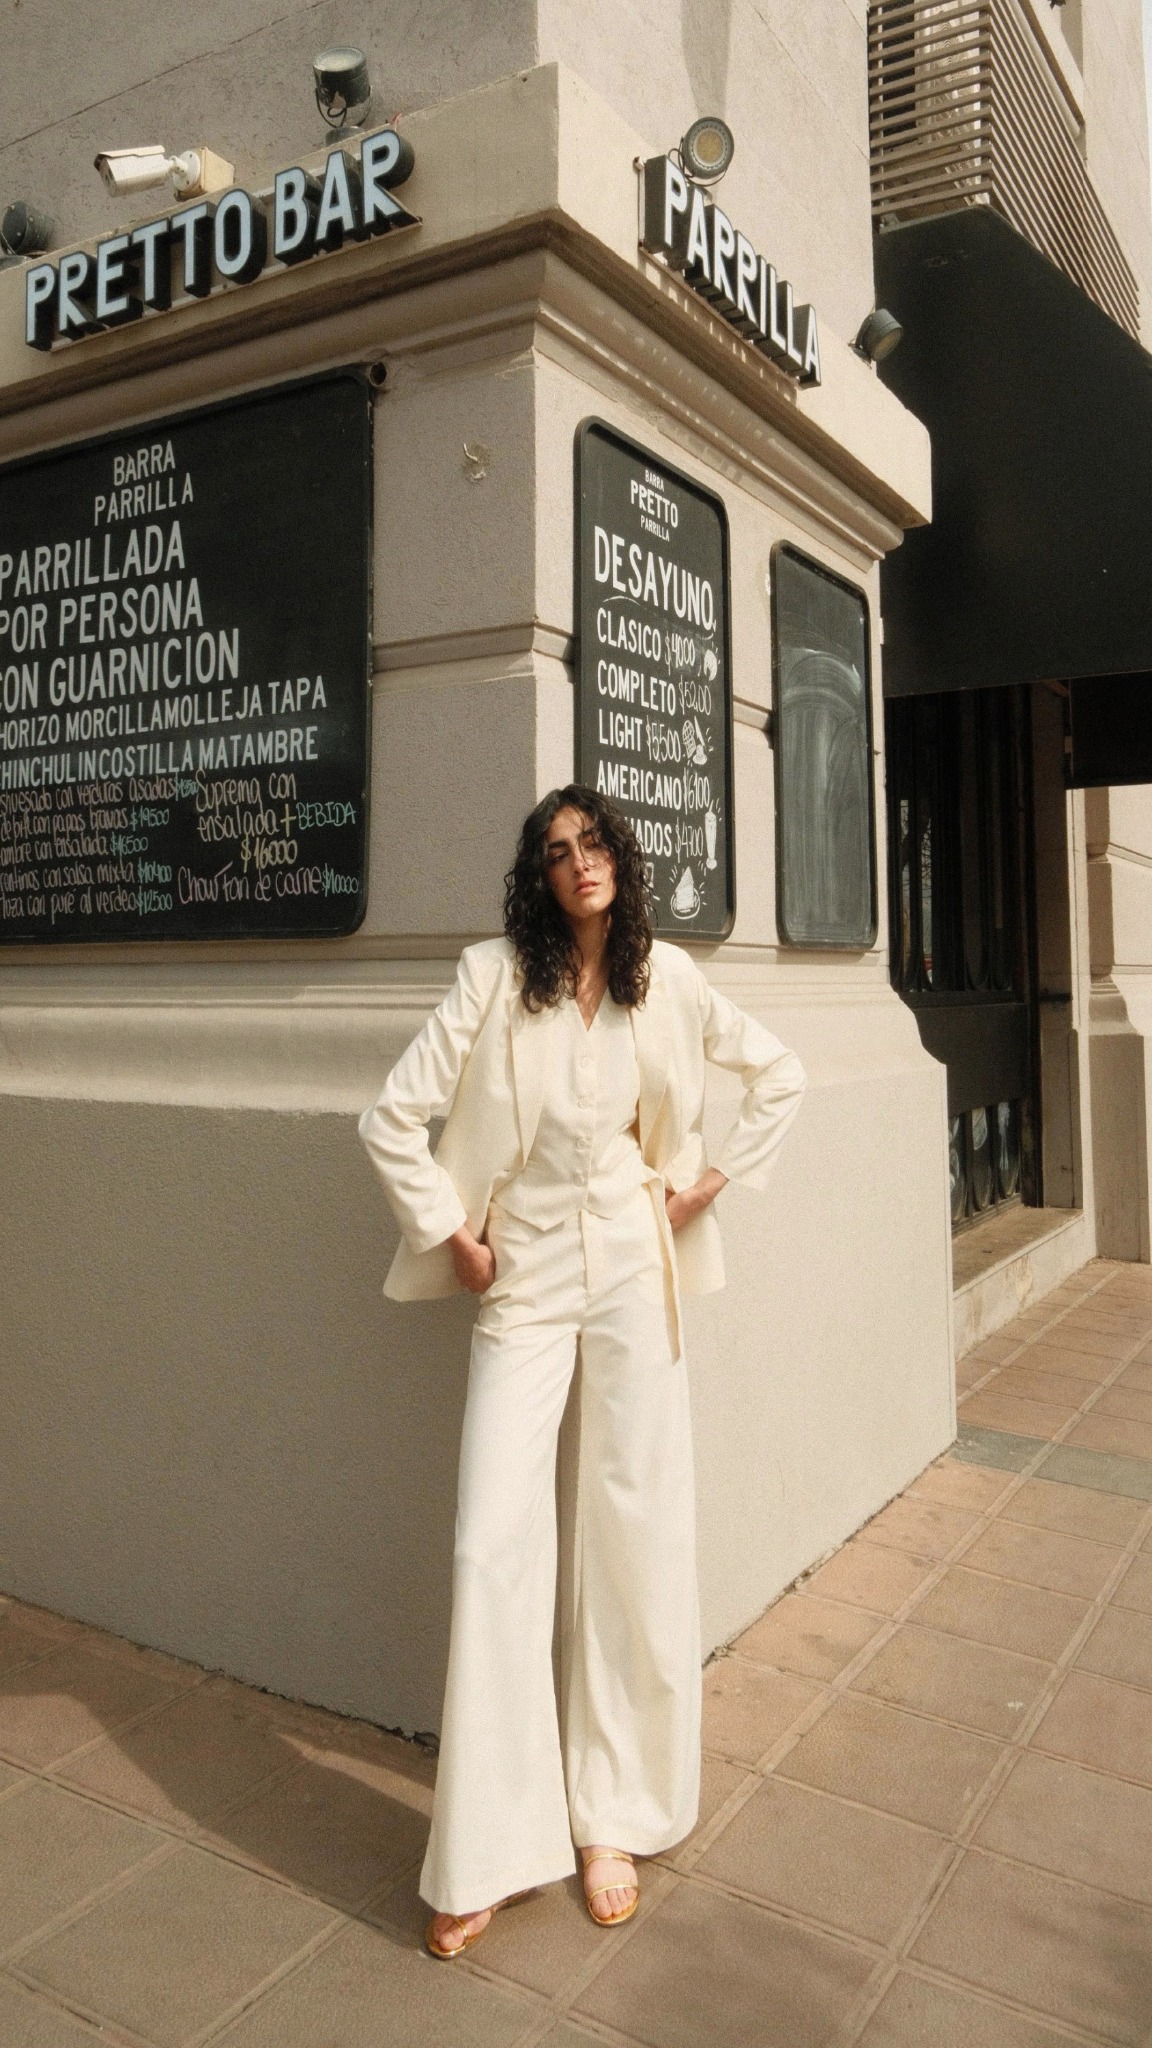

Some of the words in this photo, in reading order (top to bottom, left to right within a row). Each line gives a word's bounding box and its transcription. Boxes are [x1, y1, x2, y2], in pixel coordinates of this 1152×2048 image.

[26, 187, 262, 350] PRETTO
[274, 128, 412, 264] BAR
[660, 155, 821, 387] PARRILLA
[113, 440, 175, 486] BARRA
[645, 469, 665, 492] BARRA
[95, 472, 194, 526] PARRILLA
[630, 479, 679, 528] PRETTO
[640, 514, 670, 543] PARRILLA
[0, 520, 186, 600] PARRILLADA
[594, 525, 714, 631] DESAYUNO
[0, 602, 48, 653] POR
[59, 577, 204, 647] PERSONA
[597, 607, 661, 662] CLASICO
[664, 630, 696, 676] $4000
[0, 661, 39, 713] ON
[50, 628, 240, 706] GUARNICION
[597, 659, 676, 716] COMPLETO
[269, 675, 328, 715] TAPA
[599, 708, 643, 752] LIGHT
[0, 749, 98, 790] HINCHULIN
[99, 738, 195, 780] COSTILLA
[200, 725, 319, 771] MATAMBRE
[56, 786, 74, 810] con
[77, 778, 124, 807] verduras
[195, 768, 263, 815] Suprema
[269, 772, 296, 800] con
[597, 759, 682, 811] AMERICANO
[33, 815, 51, 835] con
[53, 812, 86, 842] papas
[90, 804, 129, 831] bravas
[34, 841, 52, 861] con
[55, 829, 109, 858] ensalada
[197, 805, 280, 843] ensalada
[296, 801, 357, 830] BEBIDA
[624, 816, 673, 858] ADOS
[43, 866, 61, 888] con
[63, 861, 96, 887] salsa
[97, 857, 136, 884] mixta
[240, 835, 298, 873] $16000
[28, 894, 46, 917] con
[80, 886, 92, 915] al
[254, 868, 272, 902] de
[275, 866, 322, 897] carne
